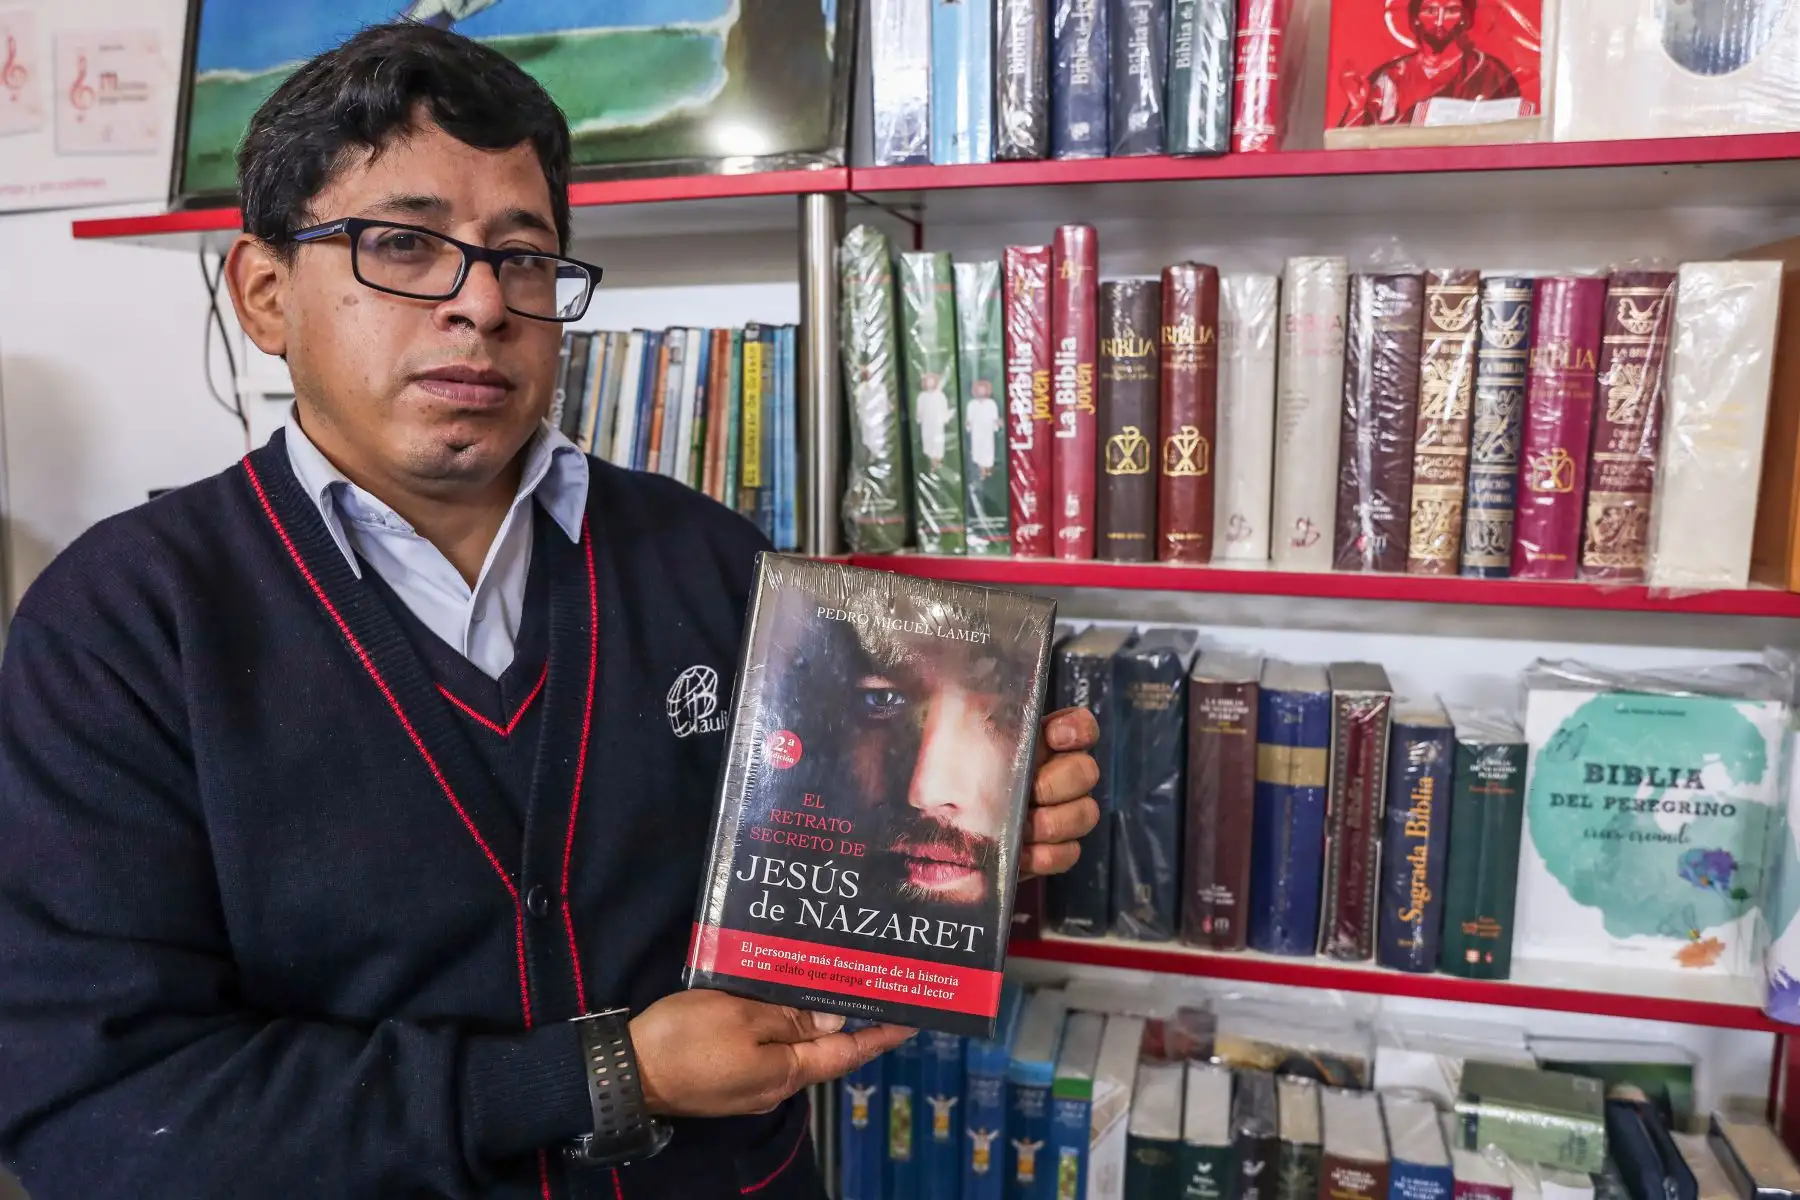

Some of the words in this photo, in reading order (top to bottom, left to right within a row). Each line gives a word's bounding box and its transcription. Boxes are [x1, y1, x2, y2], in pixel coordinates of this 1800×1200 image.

[1176, 22, 1193, 69] Biblia
[1101, 338, 1157, 357] BIBLIA
[1055, 336, 1077, 405] Biblia
[1076, 363, 1096, 415] joven
[1055, 411, 1077, 438] La
[816, 606, 869, 625] PEDRO
[873, 615, 934, 636] MIGUEL
[936, 625, 991, 645] LAMET
[1584, 763, 1705, 790] BIBLIA
[769, 808, 853, 834] RETRATO
[802, 793, 826, 809] EL
[1404, 776, 1434, 838] Biblia
[1549, 792, 1593, 809] DEL
[1602, 796, 1737, 818] PEREGRINO
[749, 825, 835, 852] SECRETO
[840, 840, 866, 857] DE
[736, 854, 860, 899] JESÚS
[1398, 845, 1432, 924] Sagrada
[749, 889, 785, 922] de
[794, 897, 985, 953] NAZARET
[741, 941, 752, 953] El
[754, 945, 807, 963] personaje
[809, 953, 831, 966] más
[833, 956, 888, 975] fascinante
[890, 965, 903, 977] de
[905, 967, 915, 979] la
[918, 969, 959, 987] historia
[741, 958, 754, 968] en
[757, 961, 771, 971] un
[774, 962, 805, 976] relato
[807, 969, 827, 981] que
[829, 972, 863, 987] atrapa
[865, 979, 873, 987] e
[874, 977, 909, 993] ilustra
[911, 984, 921, 995] al
[923, 985, 956, 1000] lector
